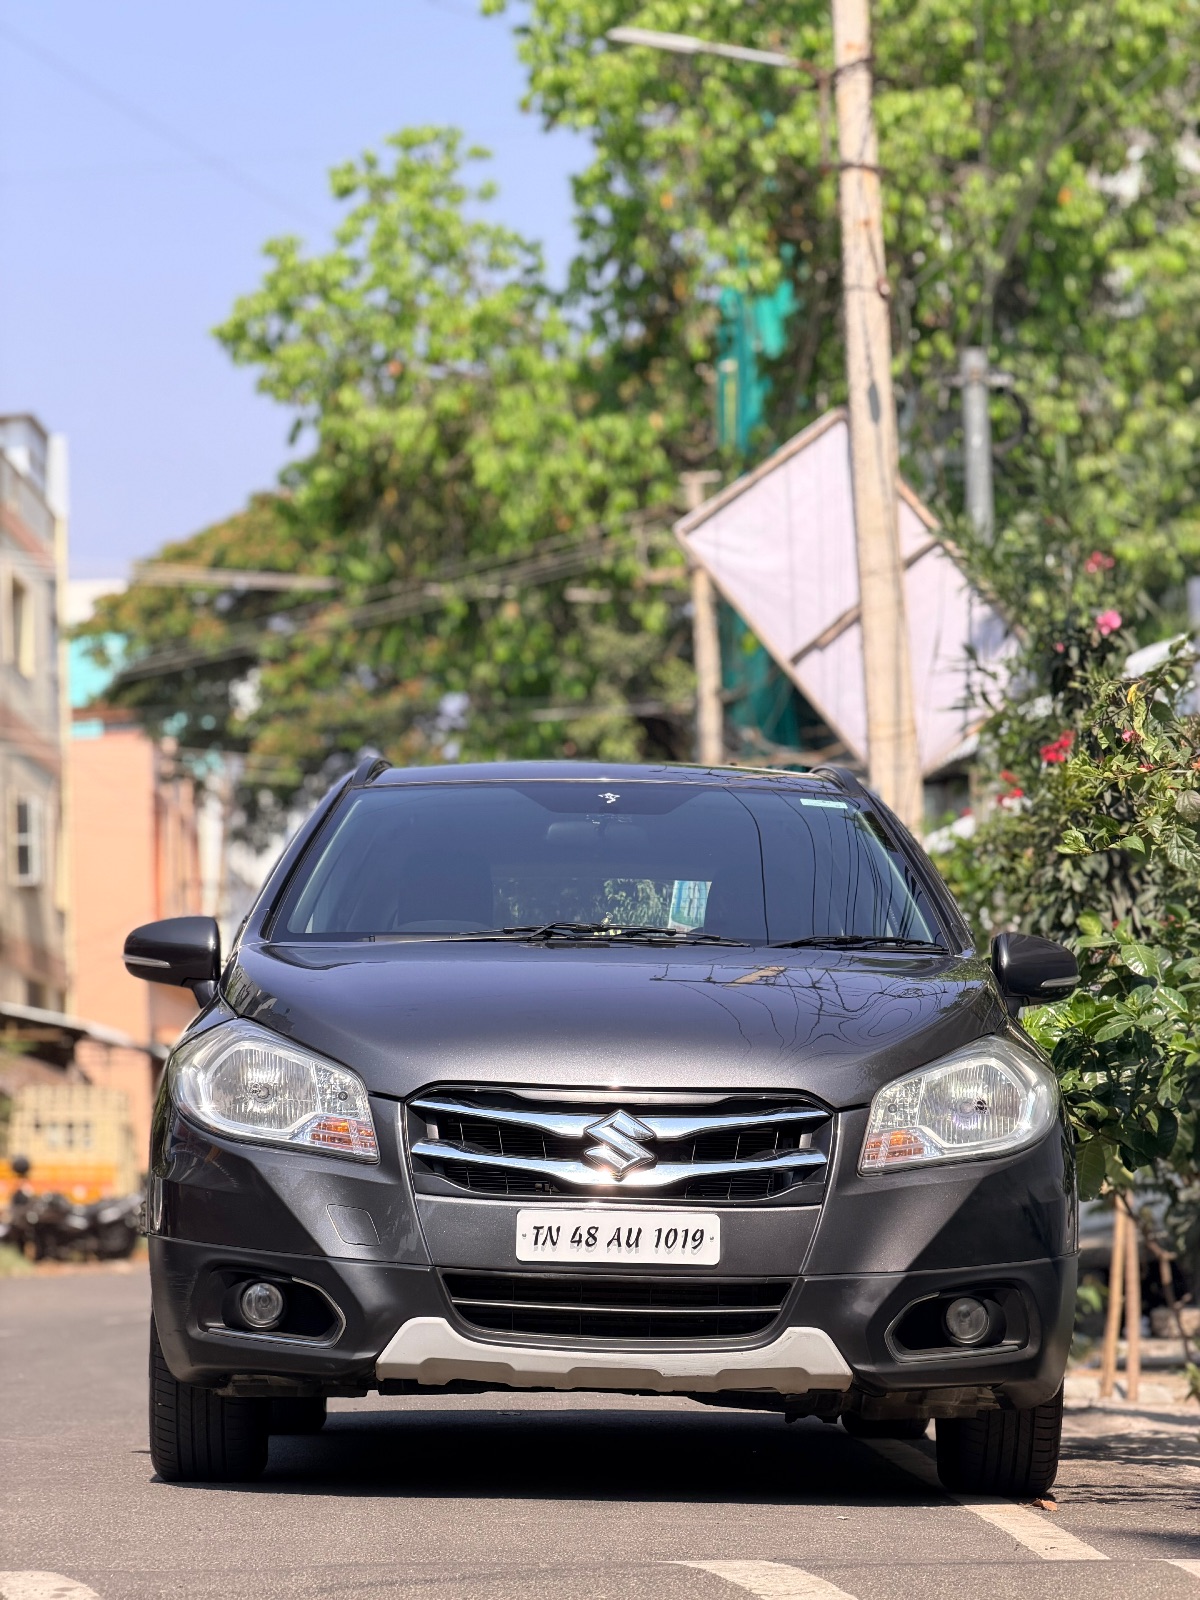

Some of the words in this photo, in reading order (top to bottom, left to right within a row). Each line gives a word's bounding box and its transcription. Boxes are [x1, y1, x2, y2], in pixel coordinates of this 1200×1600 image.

[532, 1225, 561, 1247] TN
[569, 1225, 599, 1248] 48
[606, 1226, 643, 1249] AU
[654, 1227, 705, 1250] 1019
